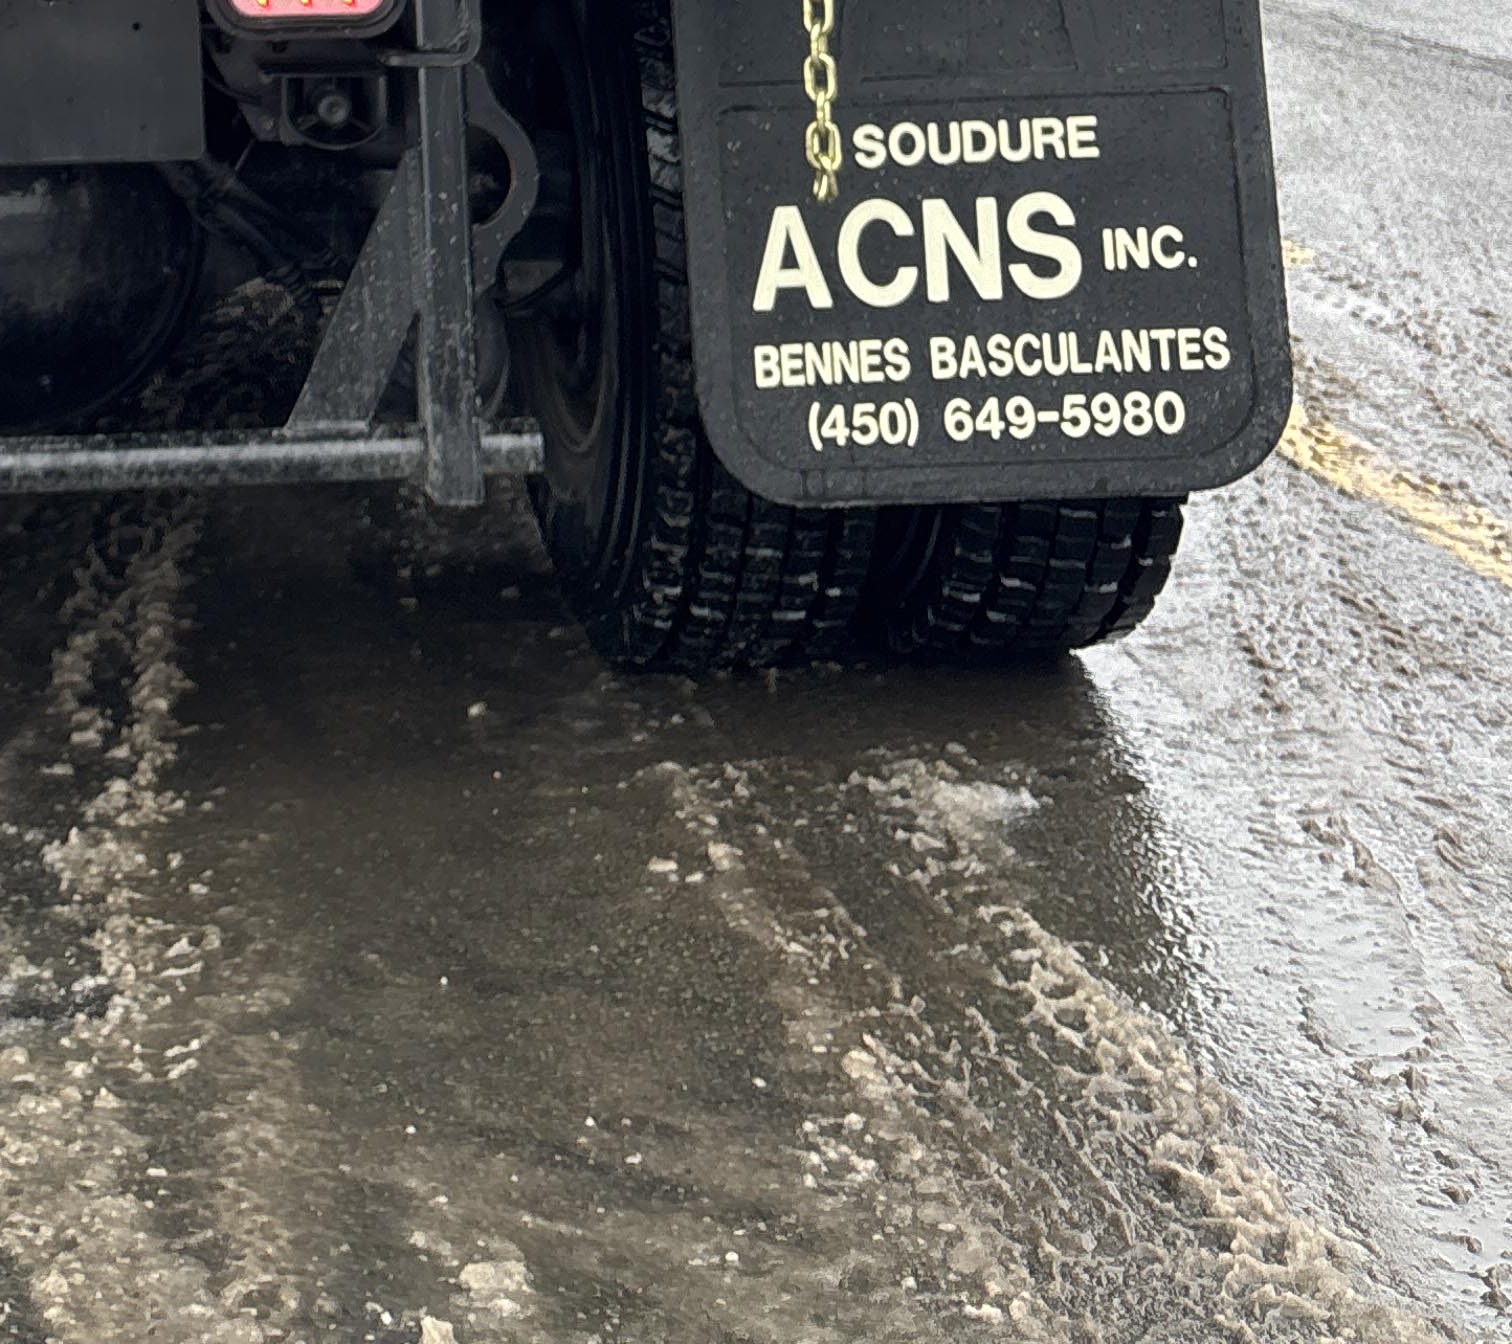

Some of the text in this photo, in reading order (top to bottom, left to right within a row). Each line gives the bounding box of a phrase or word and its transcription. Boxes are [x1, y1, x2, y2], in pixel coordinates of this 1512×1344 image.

[853, 115, 1100, 169] SOUDURE
[753, 191, 1197, 312] ACNS INC.
[754, 327, 1230, 388] BENNES BASCULANTES
[808, 391, 1186, 451] (450) 649-5980
